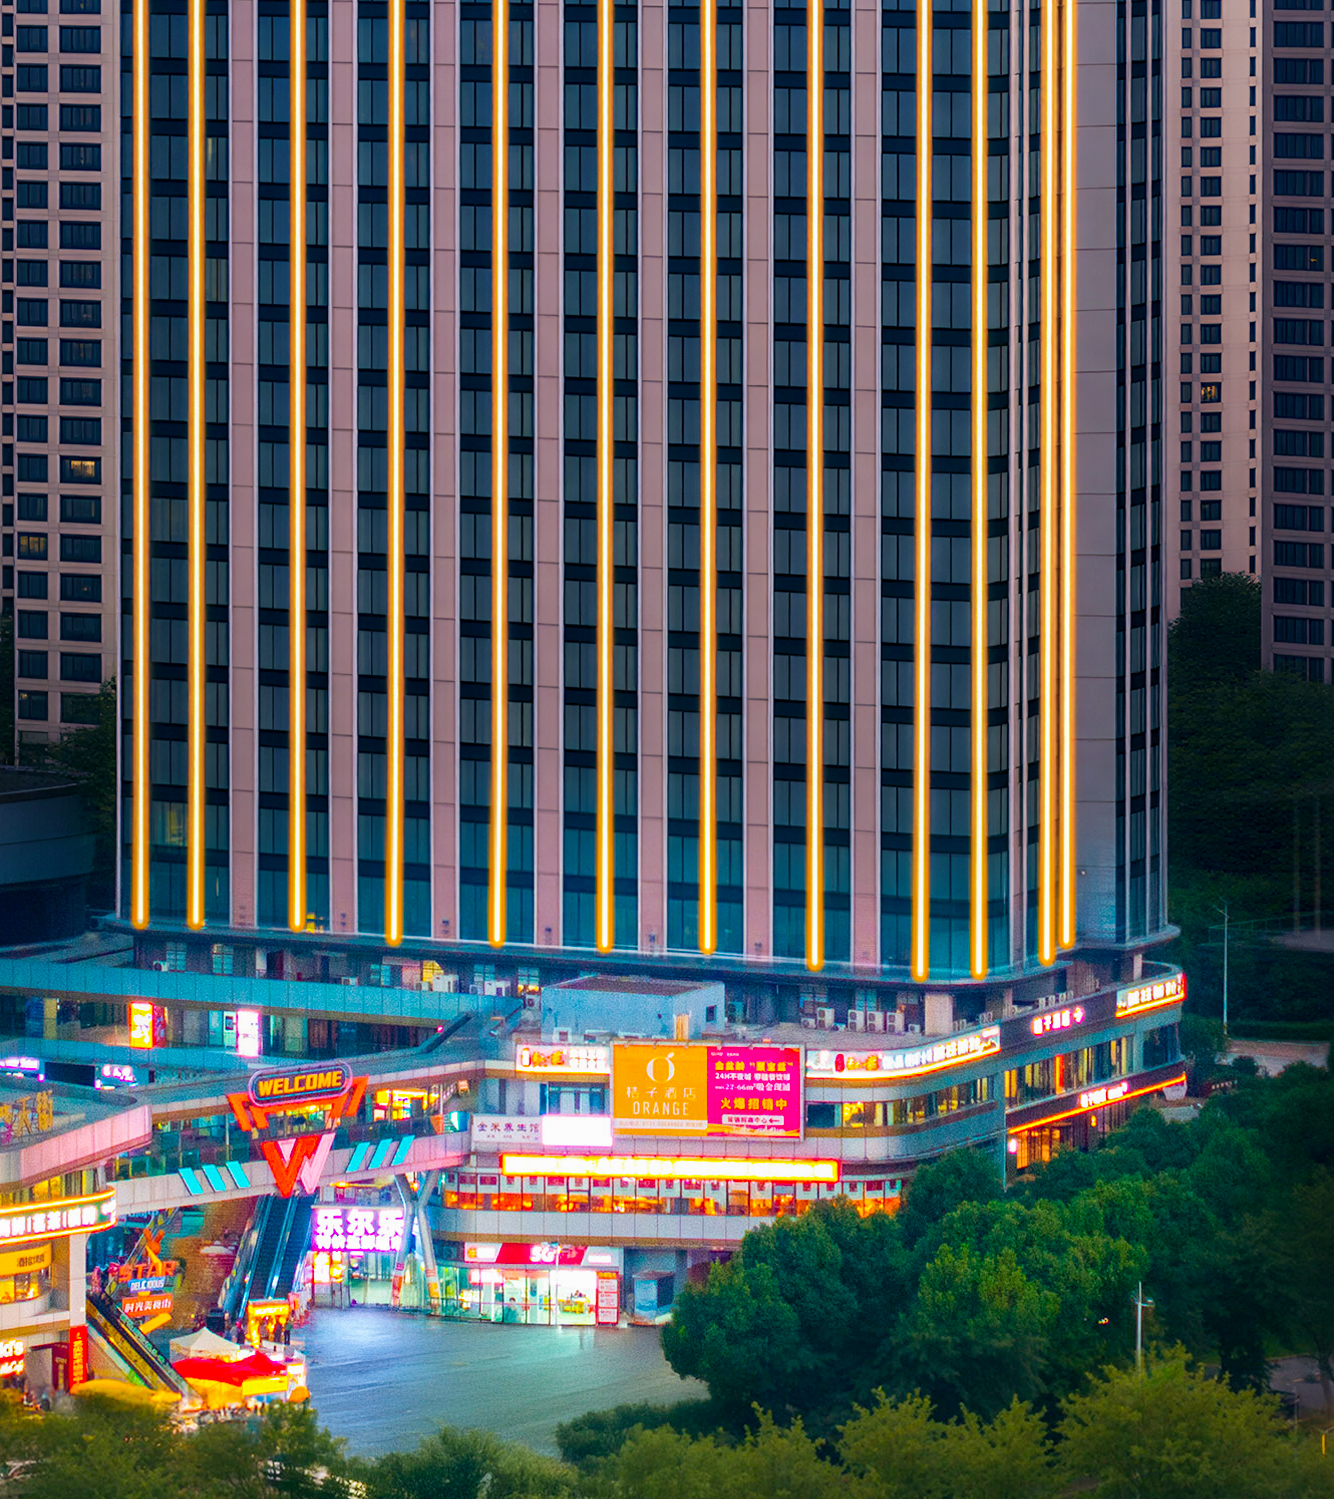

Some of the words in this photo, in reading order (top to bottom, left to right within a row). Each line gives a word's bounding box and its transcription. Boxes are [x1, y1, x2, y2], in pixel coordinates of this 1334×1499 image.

[258, 1070, 343, 1097] WELCOME
[626, 1087, 697, 1099] 桔子酒店
[633, 1101, 690, 1115] ORANGE
[316, 1208, 404, 1236] 乐尔乐
[118, 1260, 177, 1283] STAR
